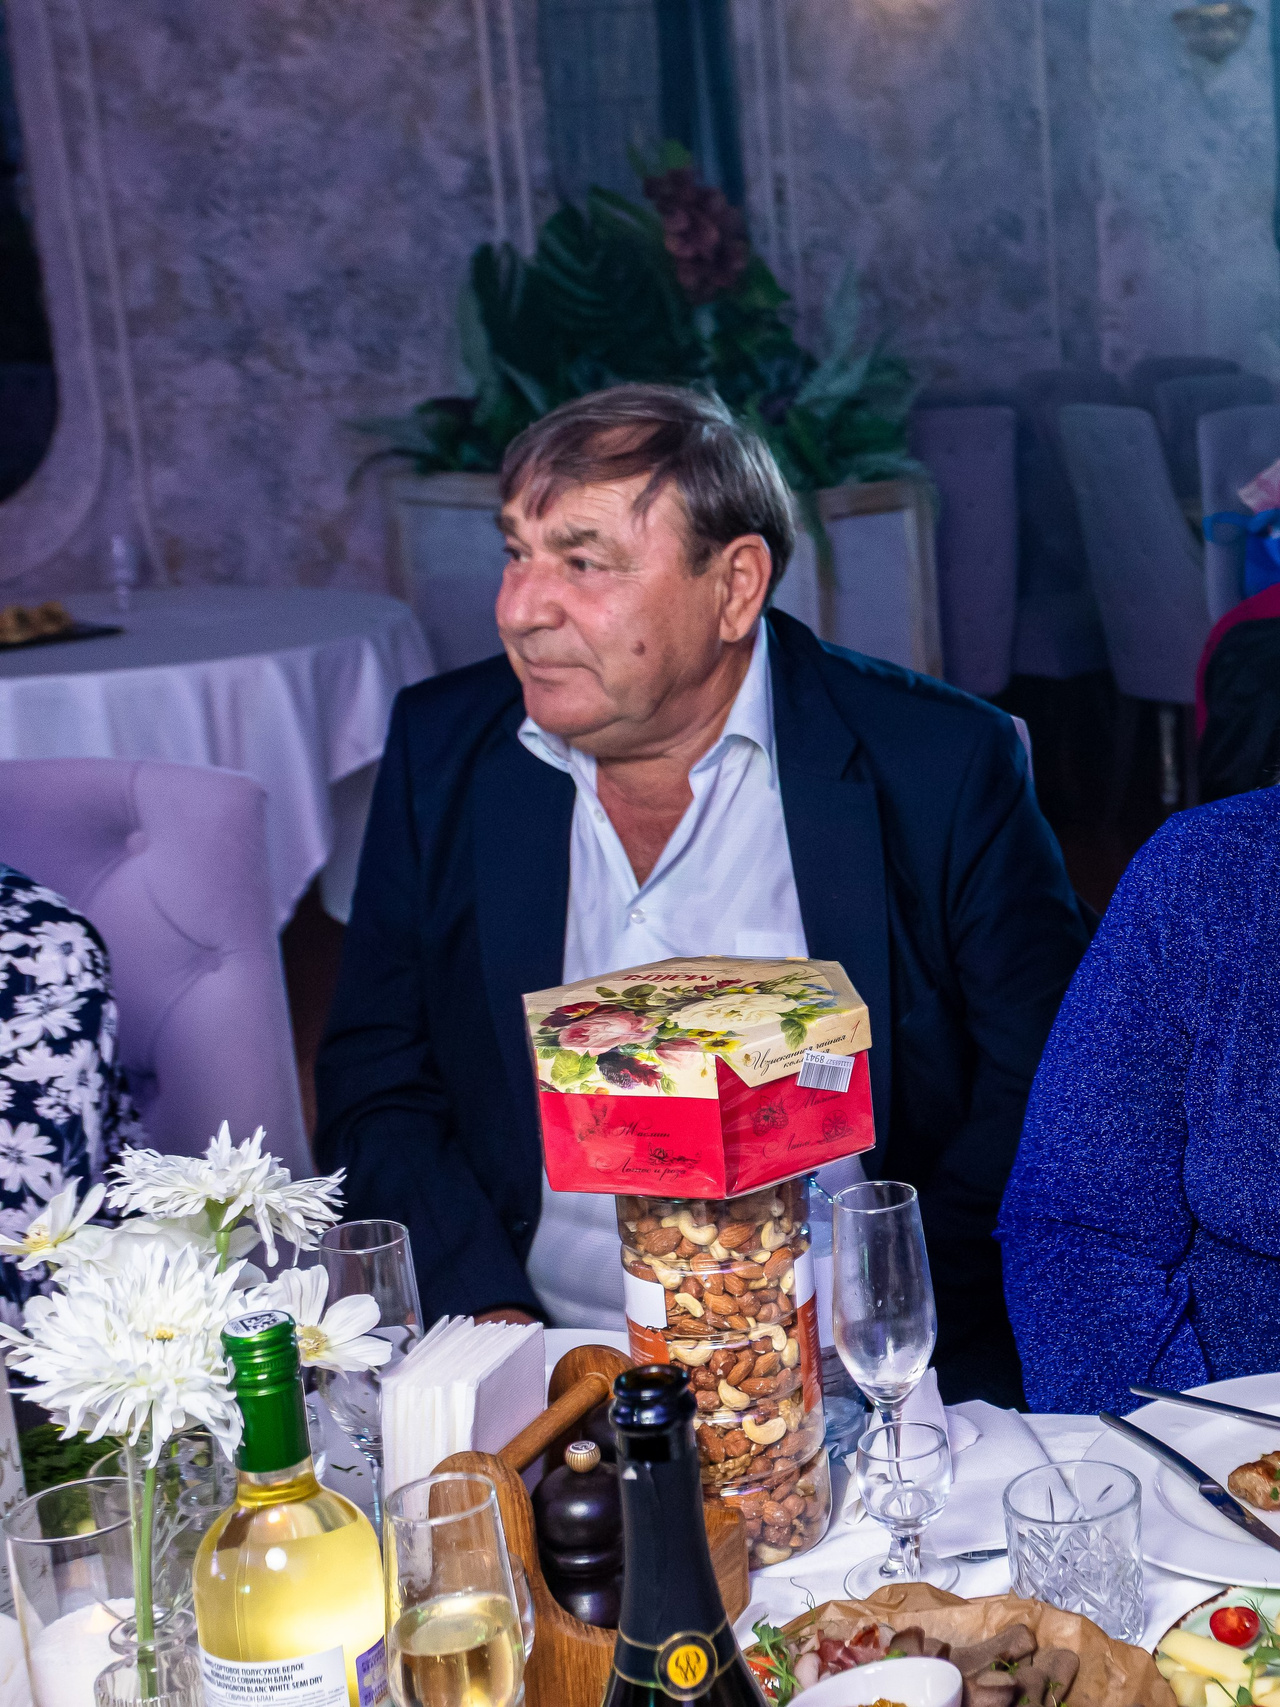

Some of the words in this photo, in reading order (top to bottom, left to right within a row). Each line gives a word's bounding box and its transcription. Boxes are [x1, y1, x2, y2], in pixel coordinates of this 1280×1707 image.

[241, 1666, 280, 1676] ПОЛУСУХОЕ
[281, 1662, 305, 1674] БЕЛОЕ
[237, 1675, 273, 1685] СОВИНЬОН
[274, 1674, 294, 1684] БЛАН
[246, 1684, 268, 1693] BLANC
[268, 1683, 290, 1693] WHITE
[291, 1679, 309, 1690] SEMI
[309, 1675, 324, 1686] DRY
